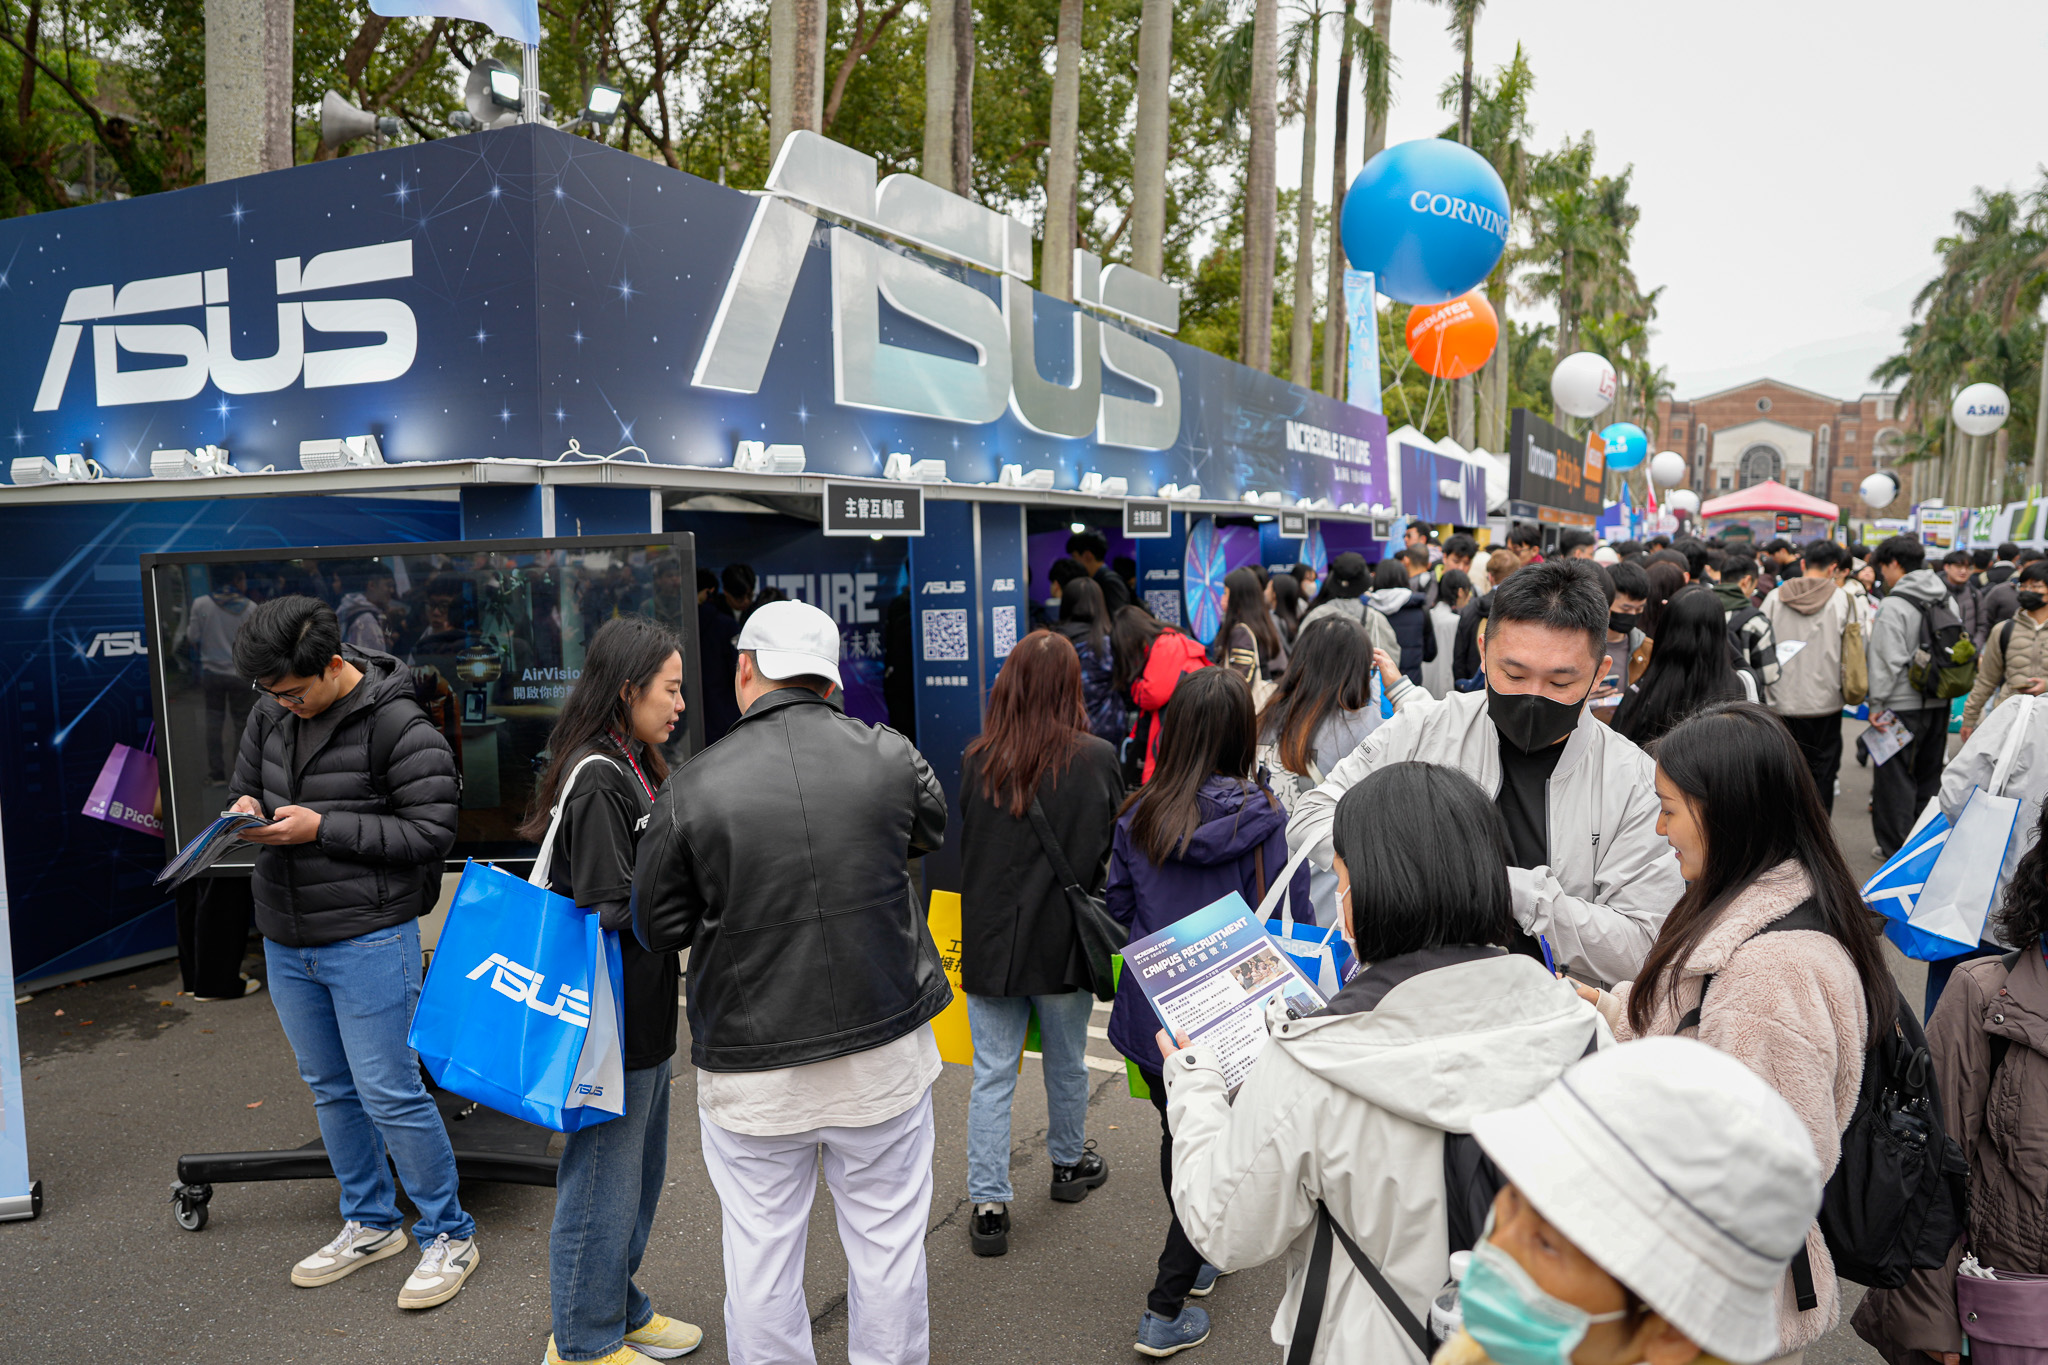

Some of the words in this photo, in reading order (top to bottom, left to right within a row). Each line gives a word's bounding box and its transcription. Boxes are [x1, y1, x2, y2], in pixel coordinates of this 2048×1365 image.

[1411, 190, 1509, 241] CORNING
[691, 129, 1182, 452] ASUS
[33, 239, 418, 412] ASUS
[844, 497, 905, 519] 主管互動區
[921, 580, 966, 595] ASUS
[992, 578, 1016, 592] ASUS
[1144, 569, 1180, 580] ASUS
[753, 572, 880, 625] TURE
[86, 631, 148, 658] ASU
[522, 666, 583, 681] AirVisio
[1142, 952, 1182, 979] CAMPUS
[1180, 916, 1248, 959] RECRUITMENT
[465, 952, 590, 1028] ASUS
[575, 1083, 603, 1097] ASUS
